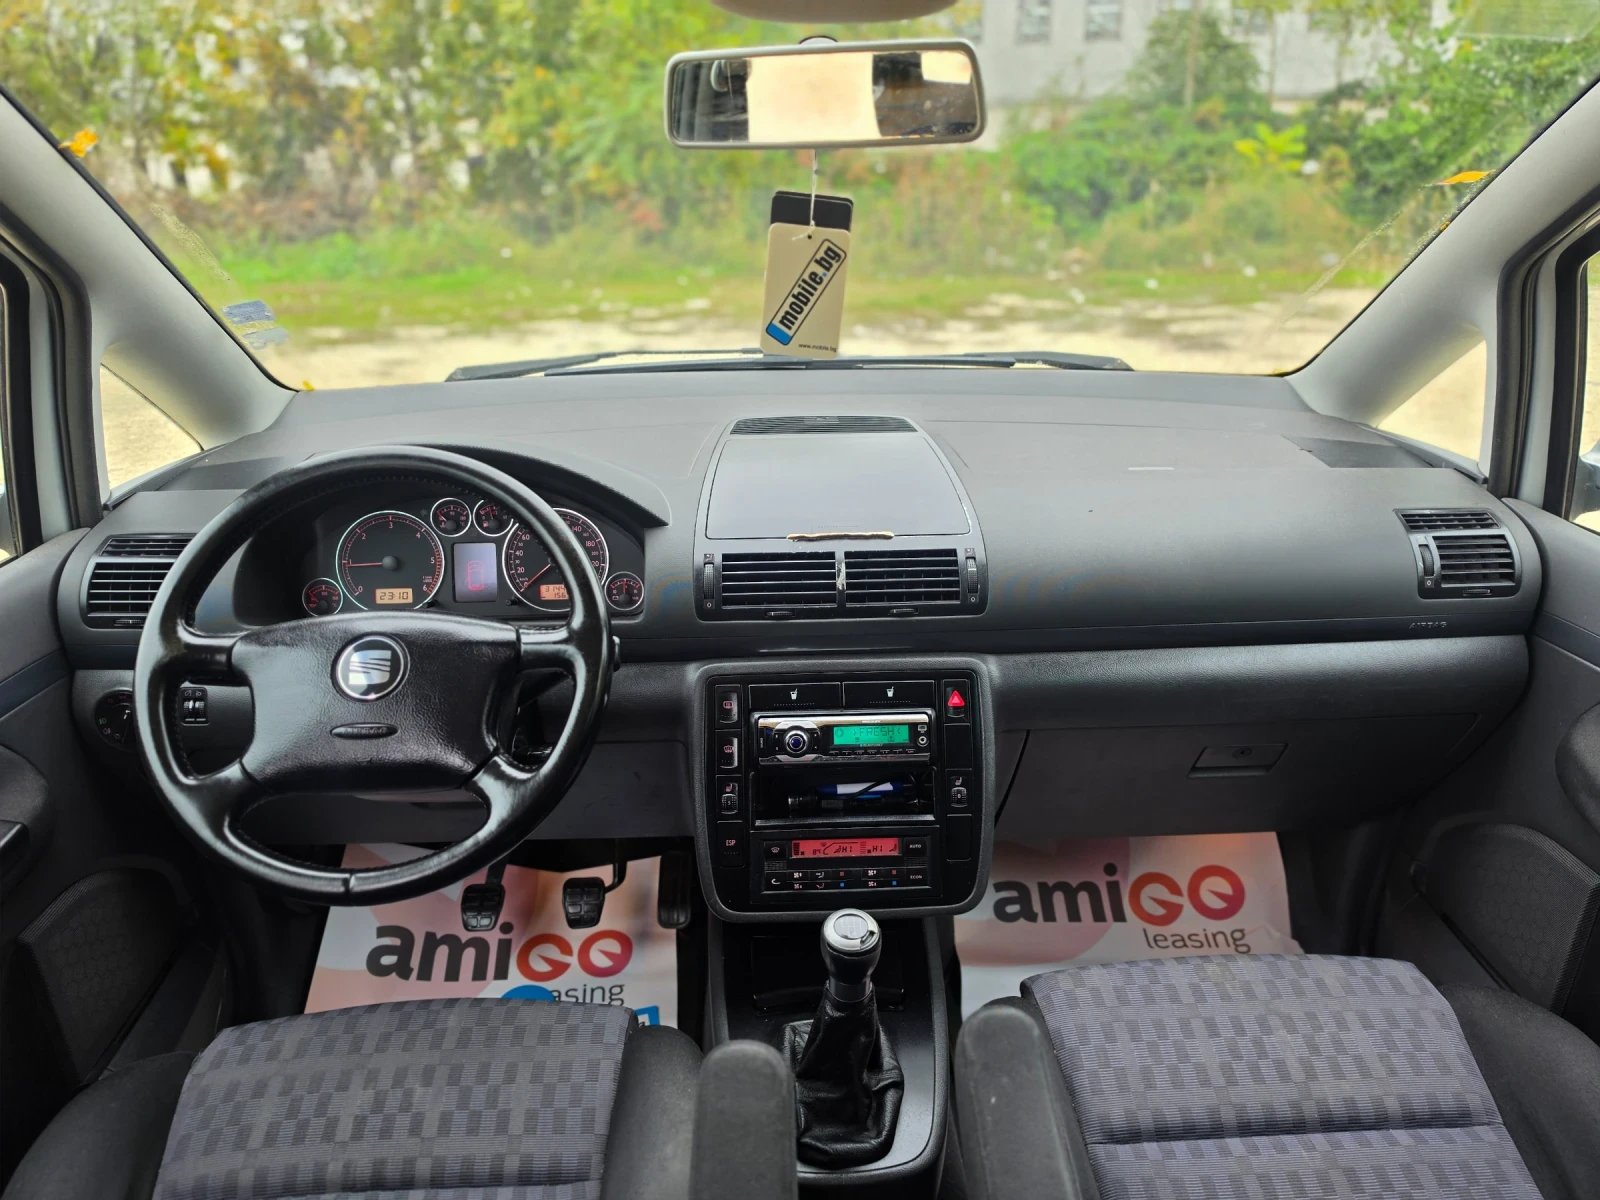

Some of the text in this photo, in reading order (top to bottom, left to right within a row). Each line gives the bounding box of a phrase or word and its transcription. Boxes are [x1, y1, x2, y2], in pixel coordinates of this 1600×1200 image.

[778, 246, 842, 331] mobile.bg
[798, 343, 837, 353] www.mobile.bg
[430, 556, 435, 564] 5
[859, 726, 895, 737] FRESH
[725, 839, 736, 847] ESP
[1143, 927, 1251, 954] leasing
[550, 983, 625, 1006] asing
